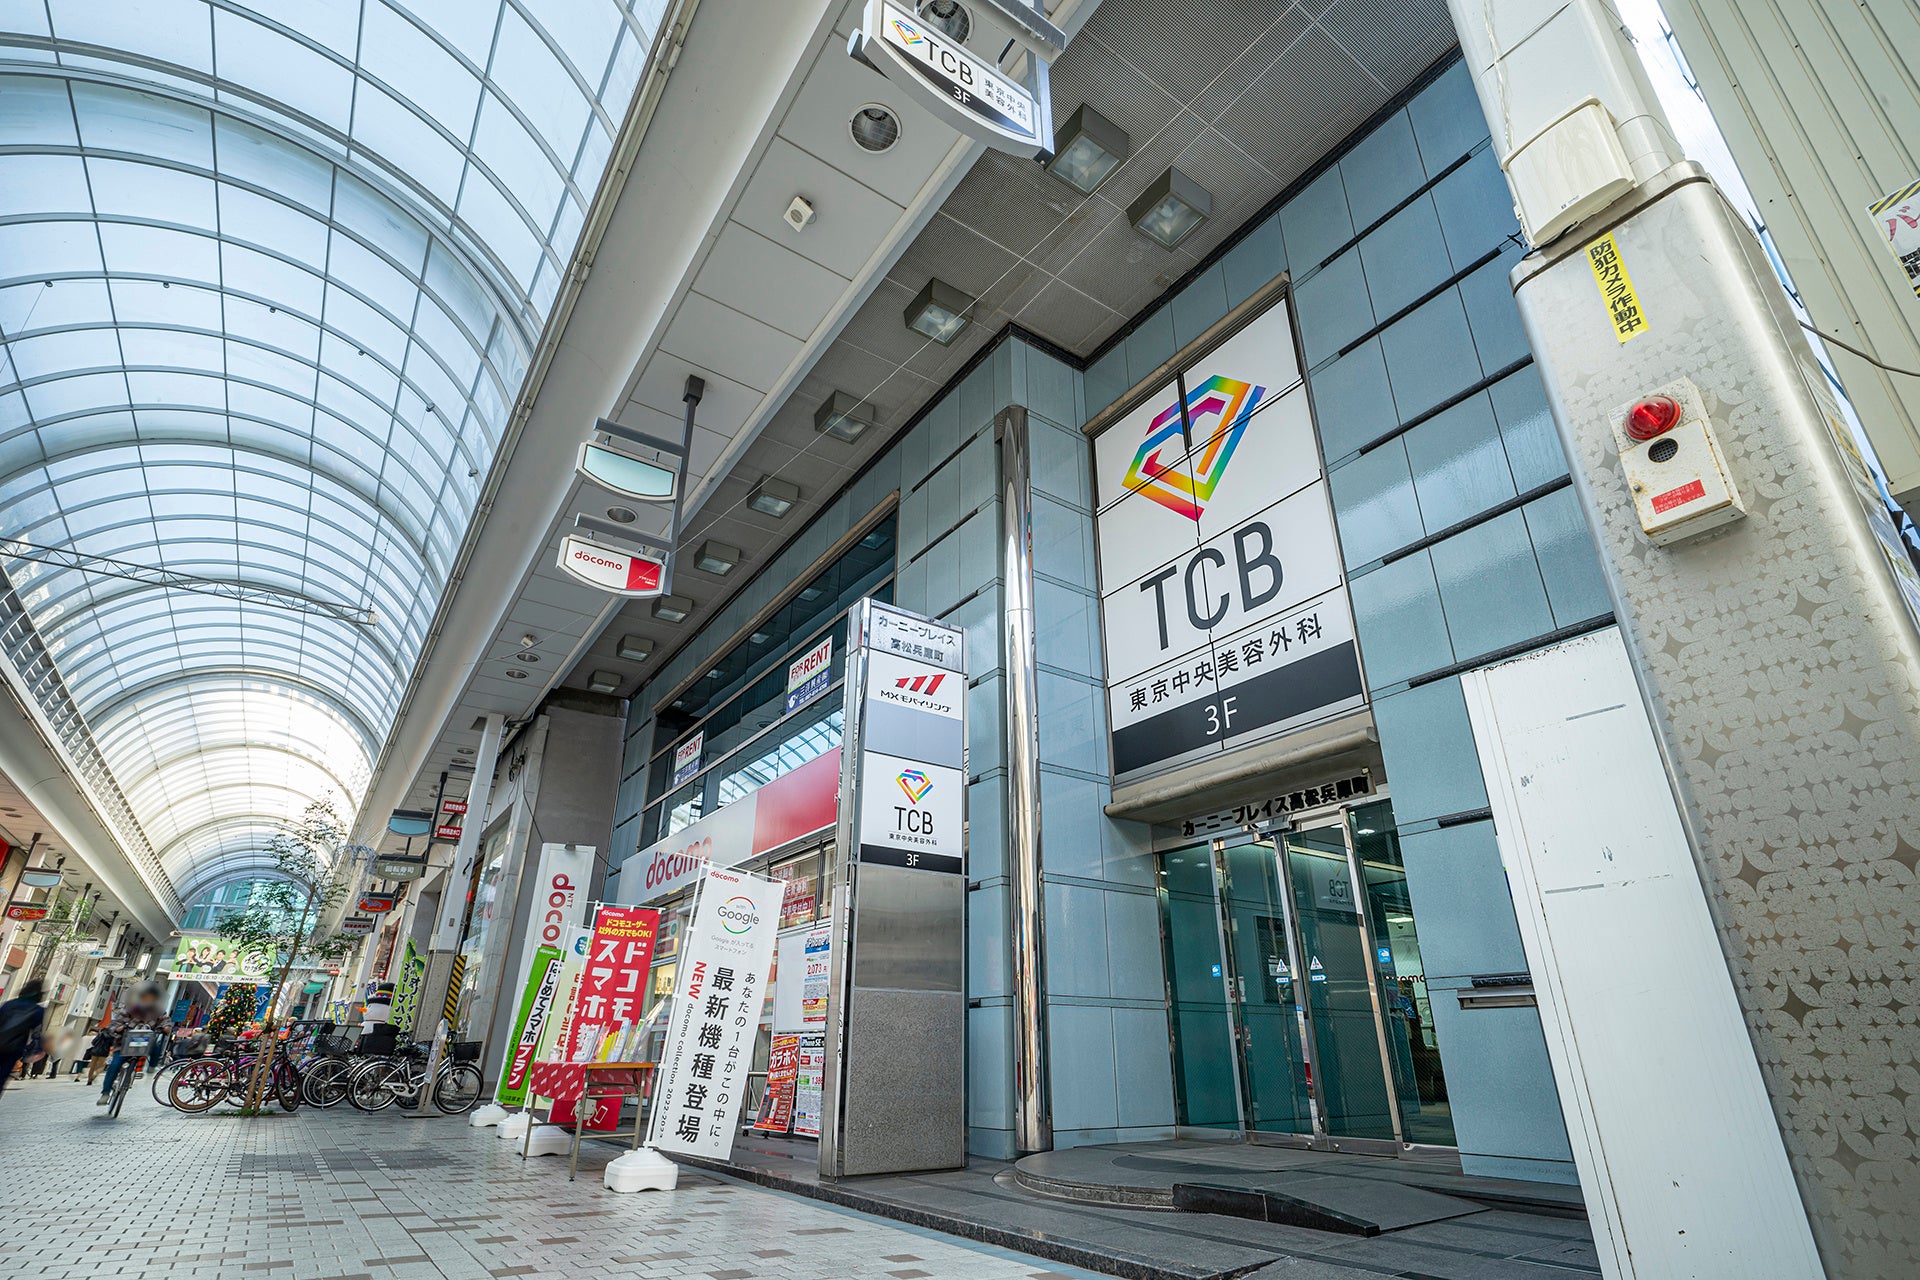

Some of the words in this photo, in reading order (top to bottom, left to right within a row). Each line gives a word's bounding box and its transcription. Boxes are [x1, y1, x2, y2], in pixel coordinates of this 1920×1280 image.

[923, 36, 974, 86] TCB
[953, 86, 971, 104] 3F
[984, 78, 1026, 112] 東京中央
[1589, 238, 1642, 334] 防犯カメラ作動中
[574, 551, 623, 570] docomo
[1139, 521, 1284, 651] TCB
[878, 615, 955, 647] カーニープレイス
[803, 642, 830, 675] RENT
[1129, 613, 1322, 712] 東京中央美容外科
[1204, 696, 1238, 735] 3F
[894, 806, 934, 835] TCB
[645, 836, 712, 890] docomo
[710, 870, 739, 883] docomo
[906, 853, 920, 867] 3F
[541, 873, 575, 948] doco
[566, 893, 574, 908] NTT
[601, 909, 625, 918] docomo
[717, 906, 760, 925] Google
[606, 918, 647, 929] ドコモユーザー
[687, 960, 707, 1000] NEW
[680, 1003, 694, 1037] docomo
[668, 1040, 685, 1085] collection
[675, 966, 735, 1144] 最新機種登場
[709, 972, 756, 1147] あなたの1台がこの中に。
